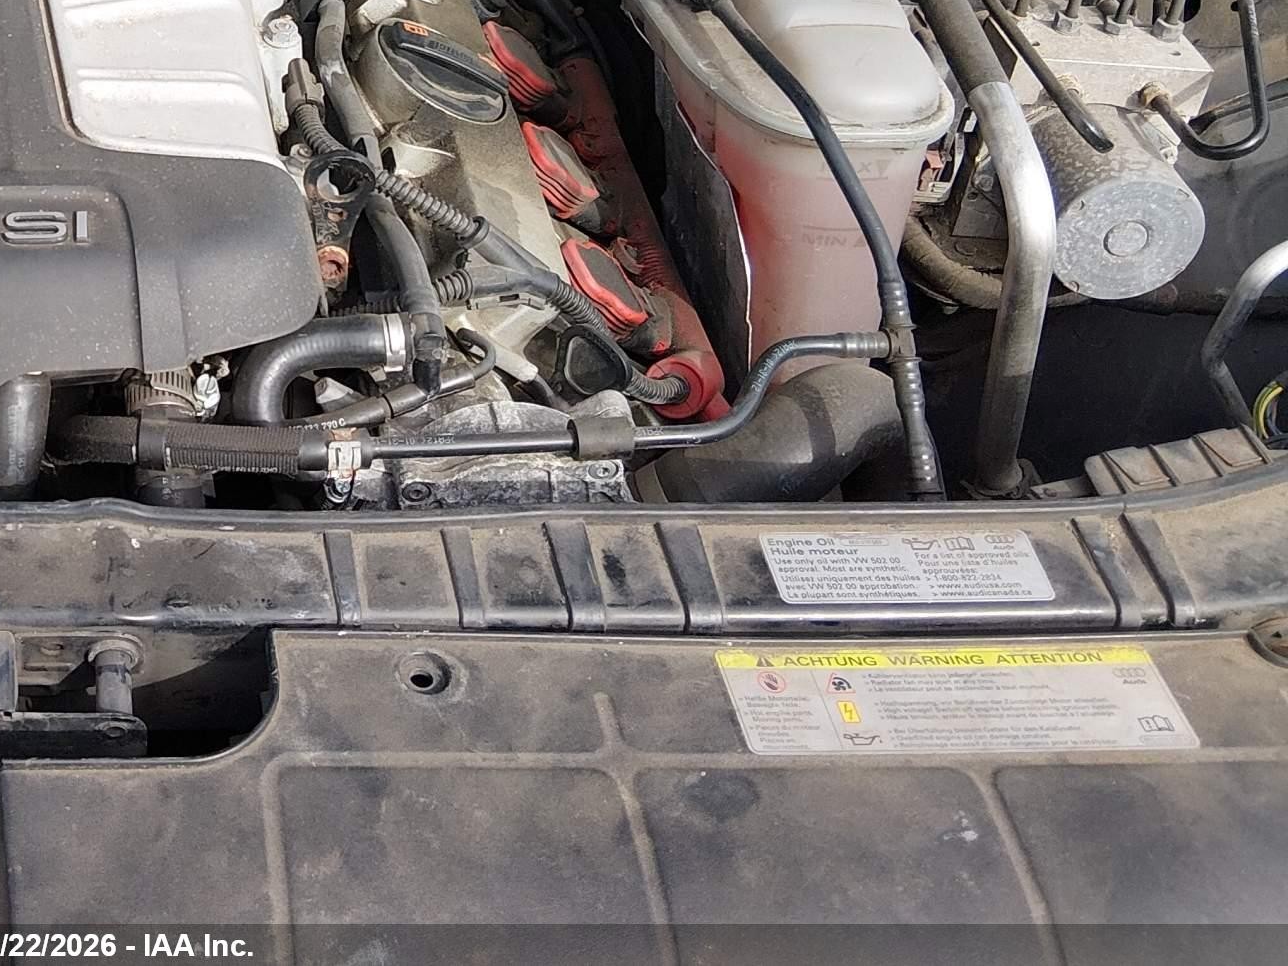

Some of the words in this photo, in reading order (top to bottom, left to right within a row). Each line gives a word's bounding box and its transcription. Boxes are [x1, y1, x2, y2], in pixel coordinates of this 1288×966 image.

[767, 538, 813, 547] Engine
[816, 538, 835, 546] Oil
[770, 547, 805, 555] Huile
[783, 655, 878, 667] ACHTUNG
[886, 653, 986, 666] WARNING
[995, 651, 1103, 665] ATTENTION
